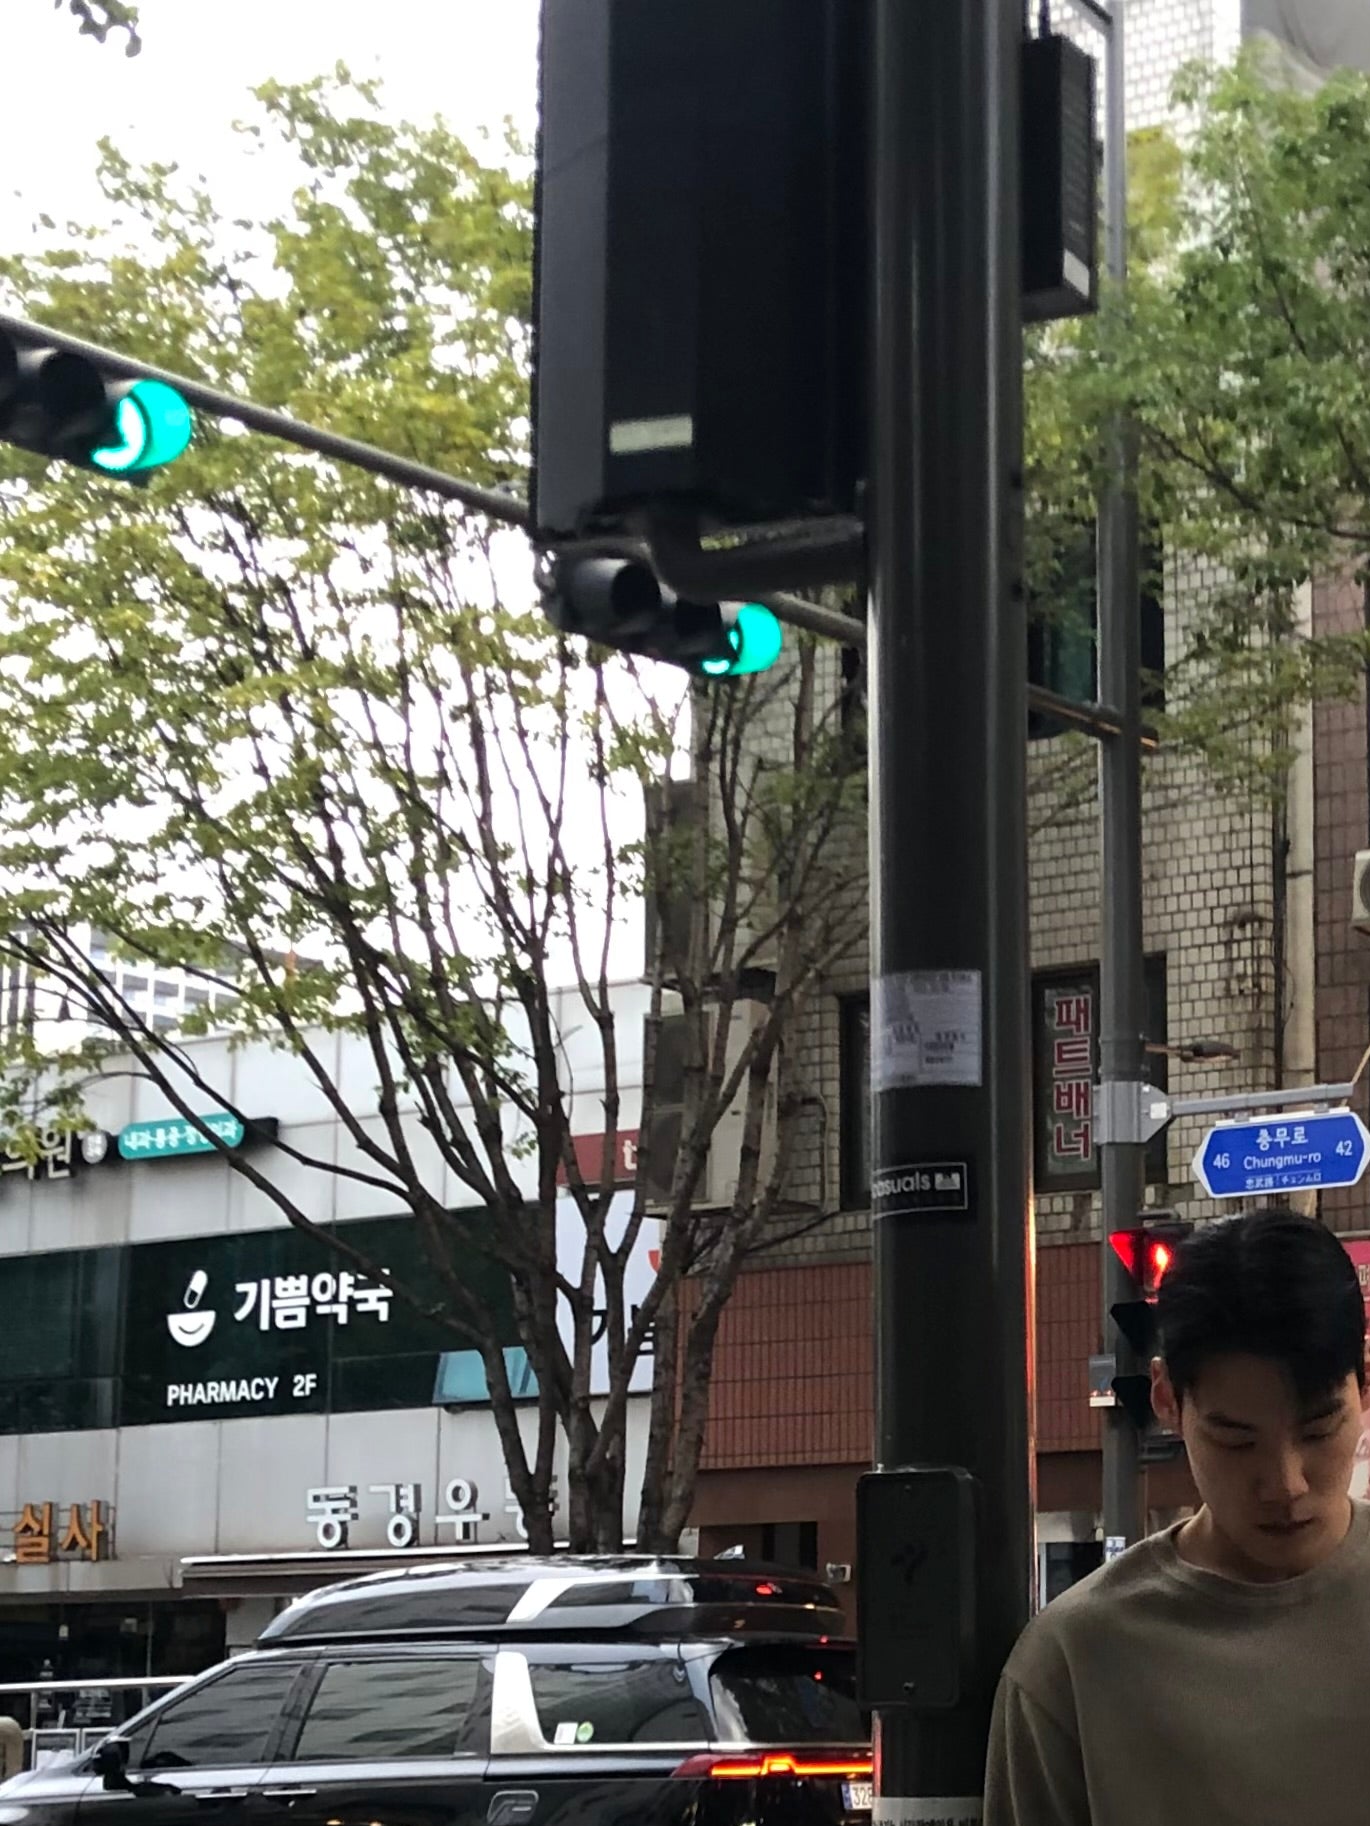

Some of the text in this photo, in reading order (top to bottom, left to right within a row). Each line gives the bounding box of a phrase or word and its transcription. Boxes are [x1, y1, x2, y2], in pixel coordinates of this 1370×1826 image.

[1256, 1126, 1308, 1151] 충무로
[1335, 1140, 1353, 1156] 42
[1213, 1153, 1230, 1169] 46
[1243, 1152, 1321, 1170] Chungmu-ro
[234, 1267, 394, 1331] 기쁨약국
[167, 1374, 317, 1406] PHARMACY 2F
[14, 1499, 104, 1563] 실사
